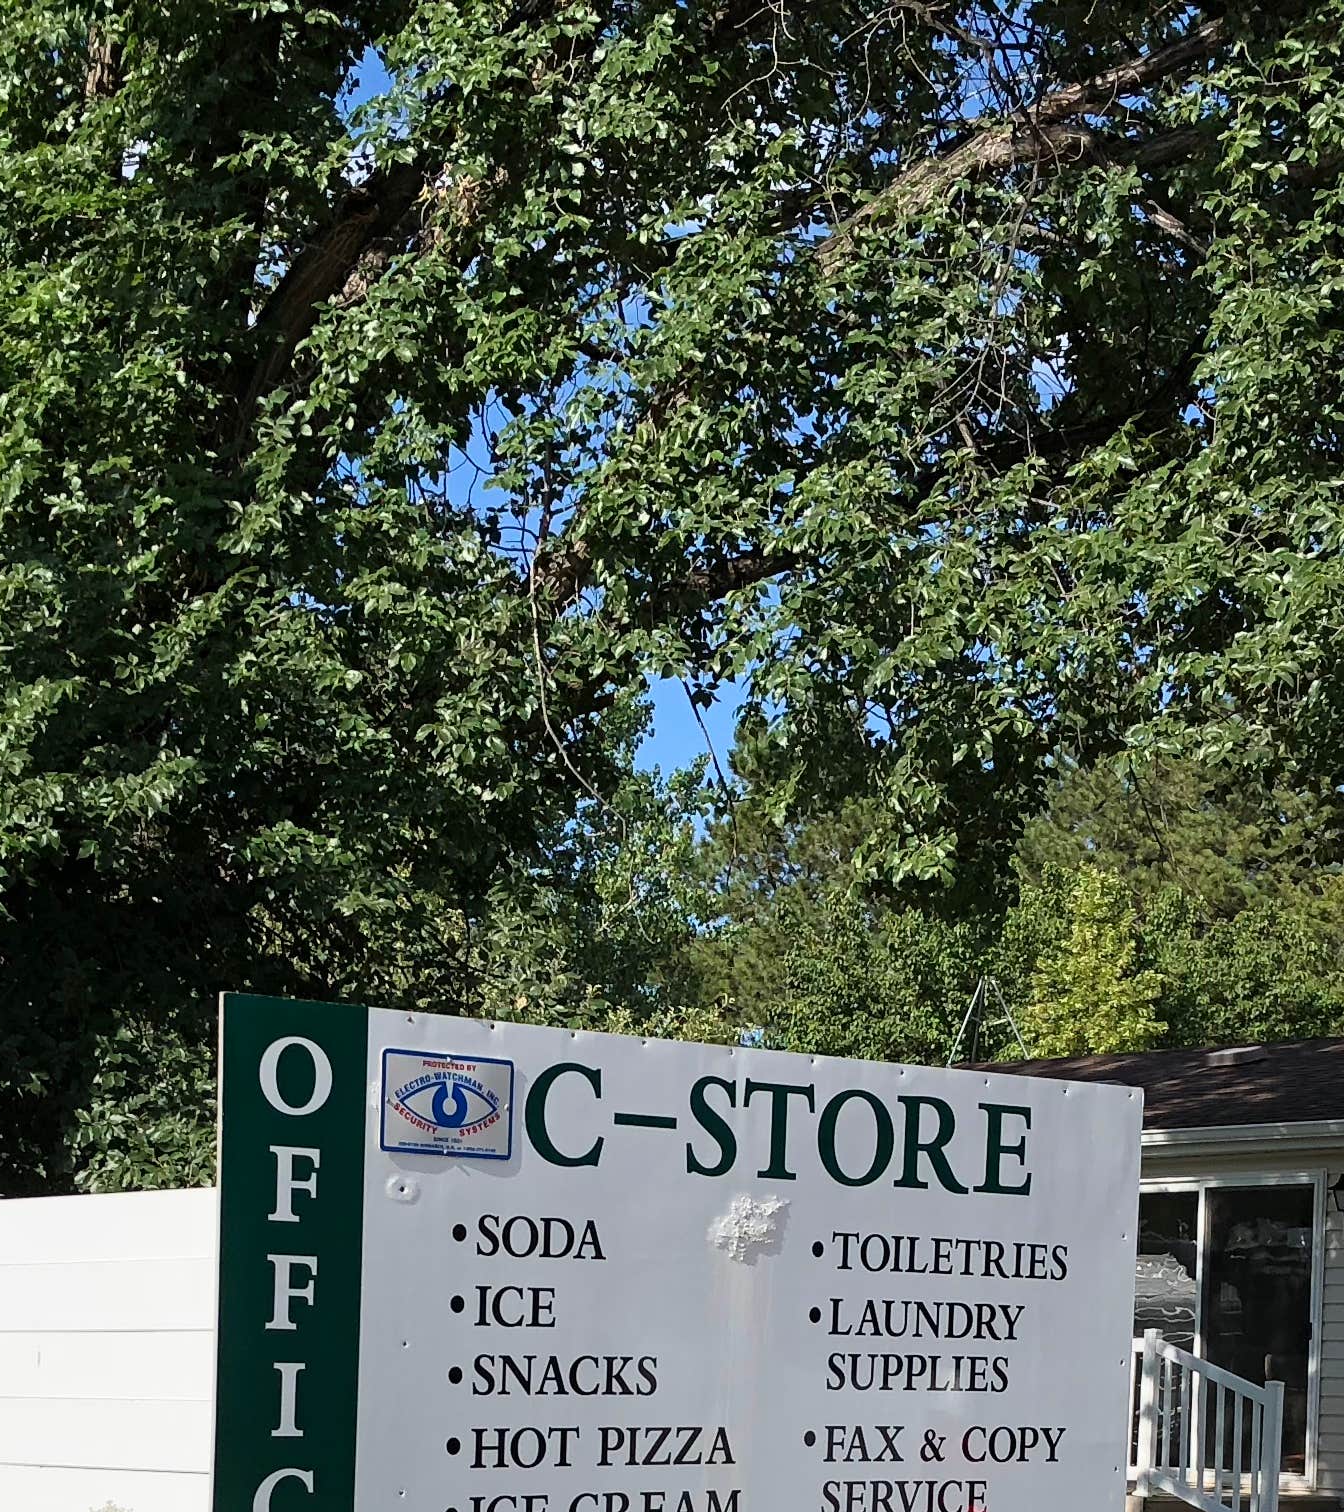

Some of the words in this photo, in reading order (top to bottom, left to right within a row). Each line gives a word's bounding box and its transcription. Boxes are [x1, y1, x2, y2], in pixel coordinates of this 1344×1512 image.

[422, 1060, 464, 1071] PROTECTED
[466, 1064, 477, 1072] BY
[393, 1102, 438, 1135] SECURITY
[458, 1111, 501, 1137] SYSTEMS
[524, 1062, 1032, 1197] C-STORE
[476, 1214, 607, 1261] SODA
[831, 1230, 1068, 1281] TOILETRIES
[473, 1285, 556, 1328] ICE
[827, 1297, 1026, 1341] LAUNDRY
[472, 1353, 658, 1397] SNACKS
[826, 1352, 1009, 1393] SUPPLIES
[469, 1425, 580, 1469] HOT
[596, 1426, 737, 1467] PIZZA
[822, 1425, 905, 1463] FAX
[919, 1428, 947, 1463] &
[961, 1425, 1067, 1463] COPY
